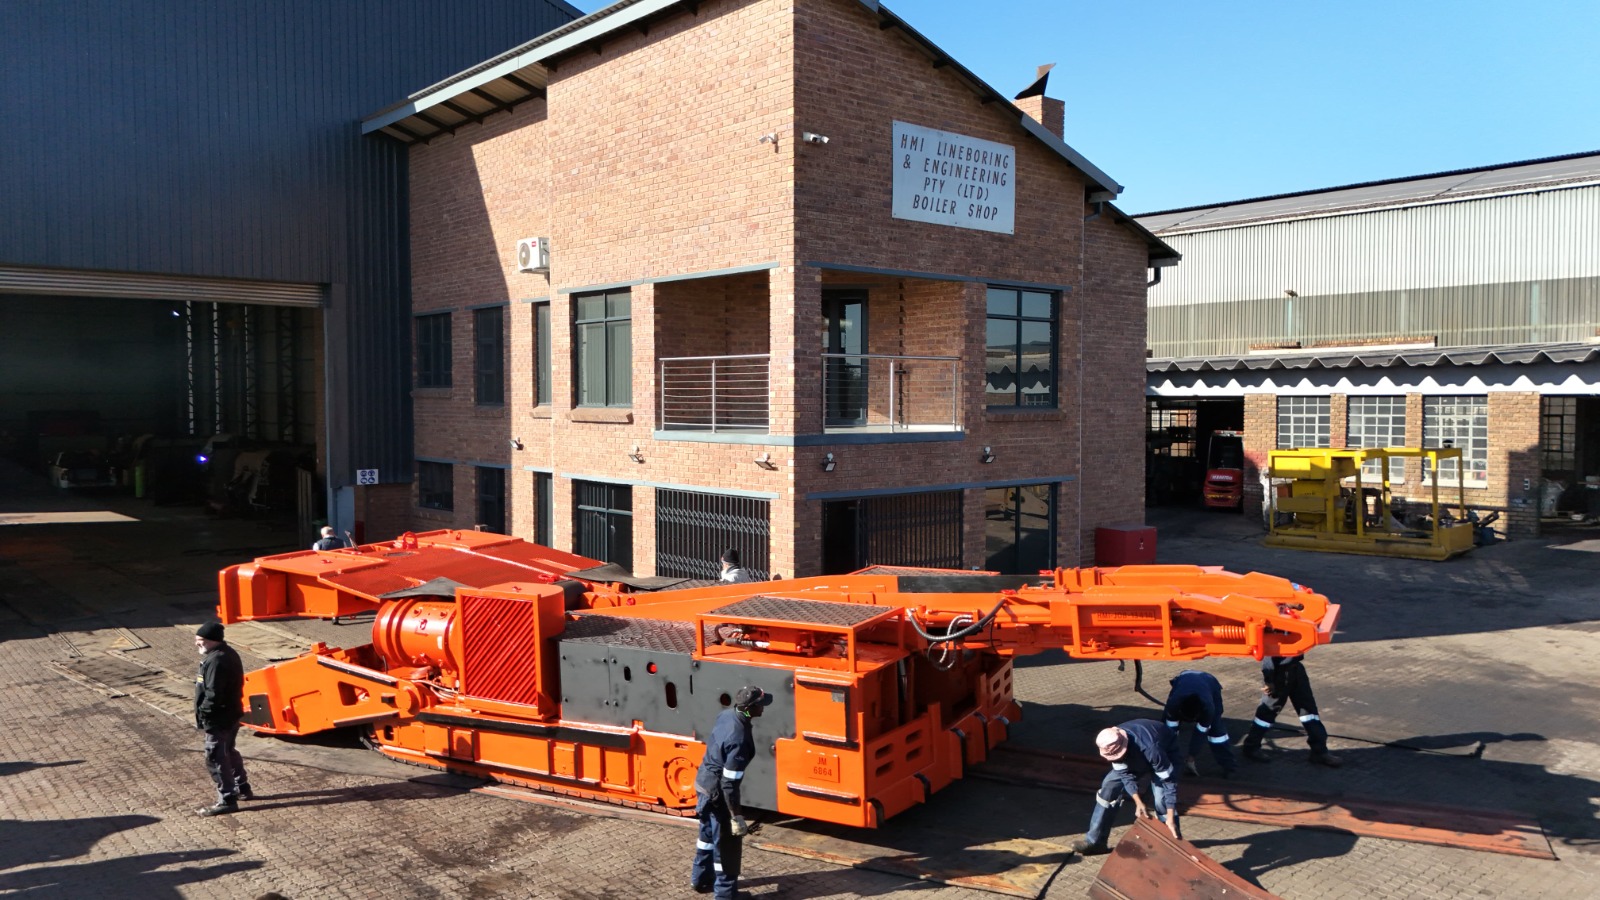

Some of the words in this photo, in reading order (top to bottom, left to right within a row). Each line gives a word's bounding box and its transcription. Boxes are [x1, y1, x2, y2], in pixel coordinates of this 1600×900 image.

[901, 134, 924, 152] HMI
[937, 141, 1009, 169] LINEBORING
[903, 154, 911, 169] &
[924, 158, 1007, 187] ENGINEERING
[923, 177, 945, 194] PTY
[957, 183, 989, 201] (LTD)
[912, 194, 957, 215] BOILER
[967, 203, 998, 221] SHOP
[813, 766, 832, 776] 6864
[817, 757, 827, 765] JM
